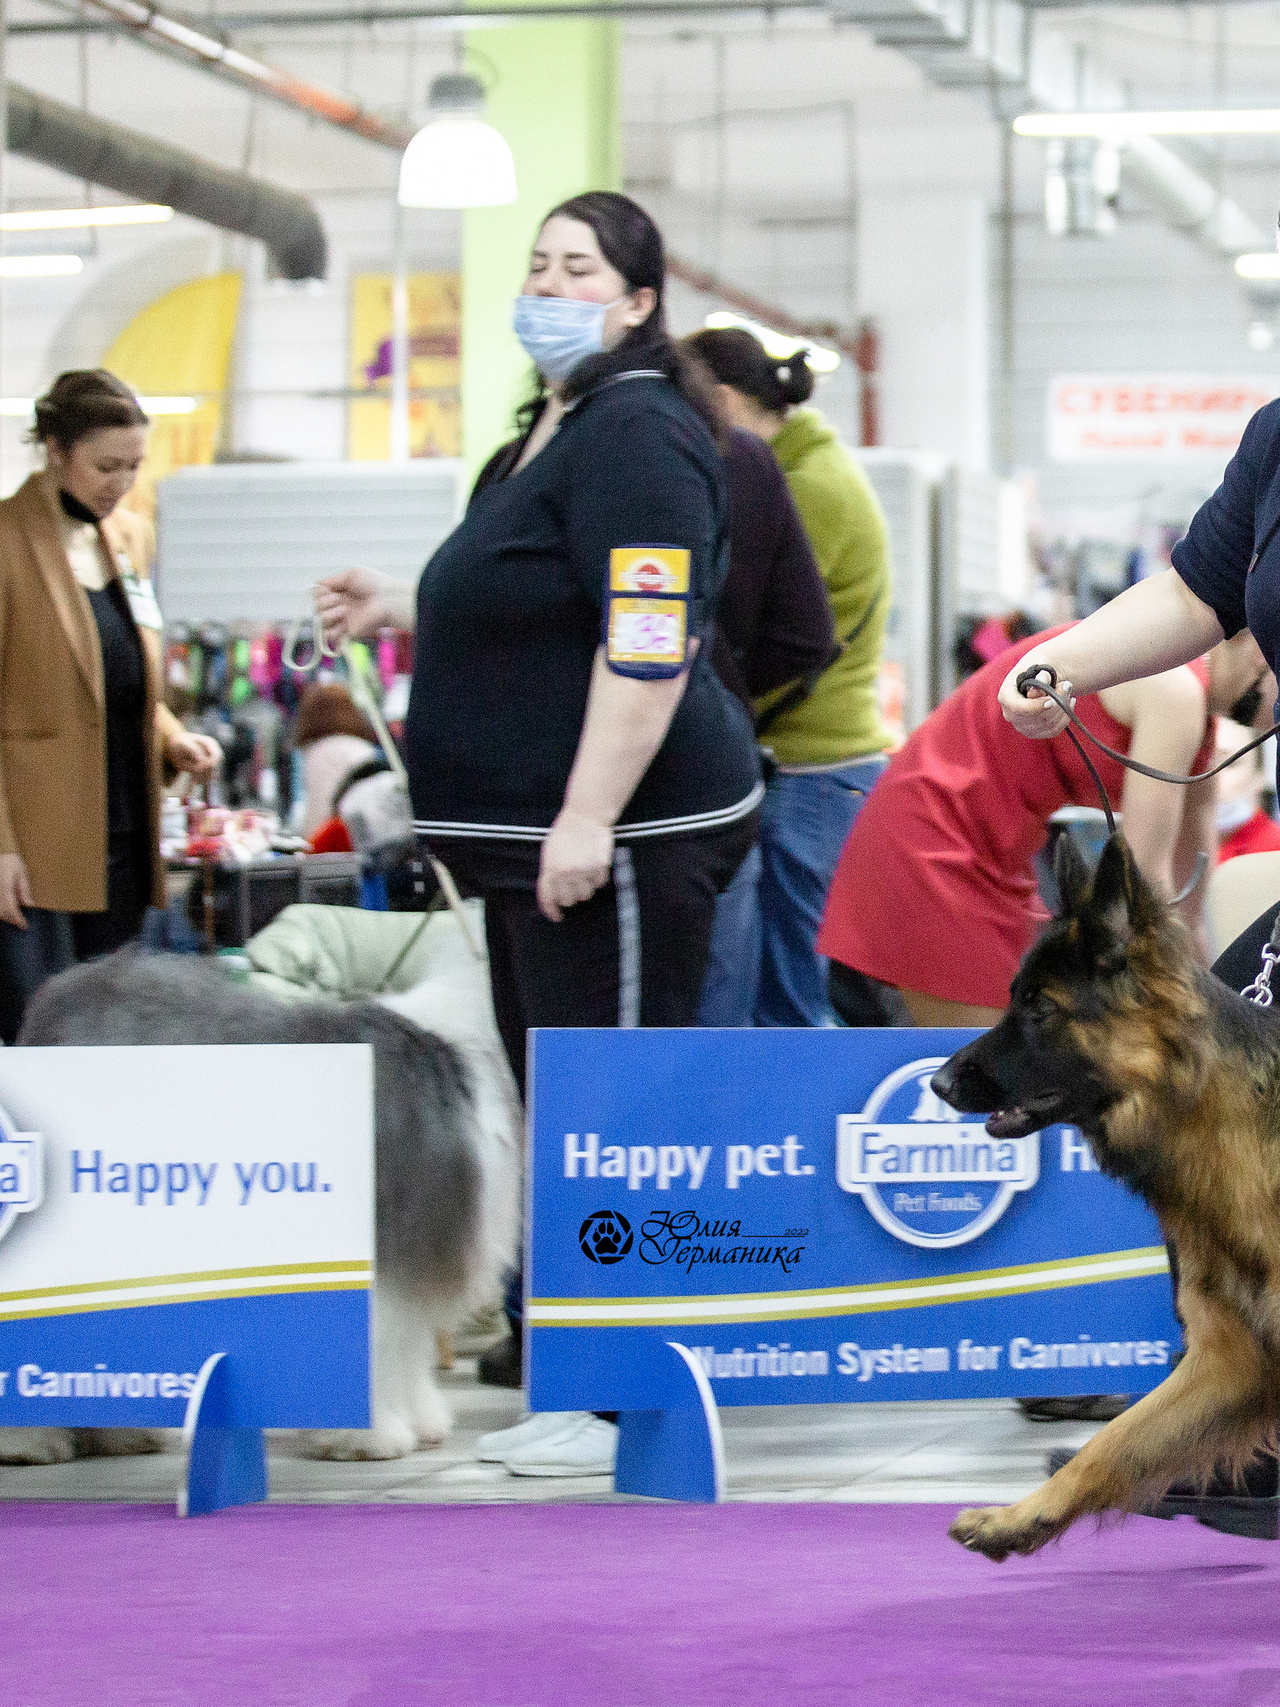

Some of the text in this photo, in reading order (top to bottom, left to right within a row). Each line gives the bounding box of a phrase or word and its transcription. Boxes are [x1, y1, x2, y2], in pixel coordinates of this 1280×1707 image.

[563, 1132, 816, 1190] Happy pet.
[859, 1131, 1017, 1174] Farmina
[70, 1149, 218, 1206] Happy
[232, 1161, 332, 1206] you.
[17, 1363, 198, 1399] Carnivores
[837, 1341, 950, 1382] System
[957, 1338, 1002, 1371] for
[1009, 1334, 1171, 1369] Carnivores
